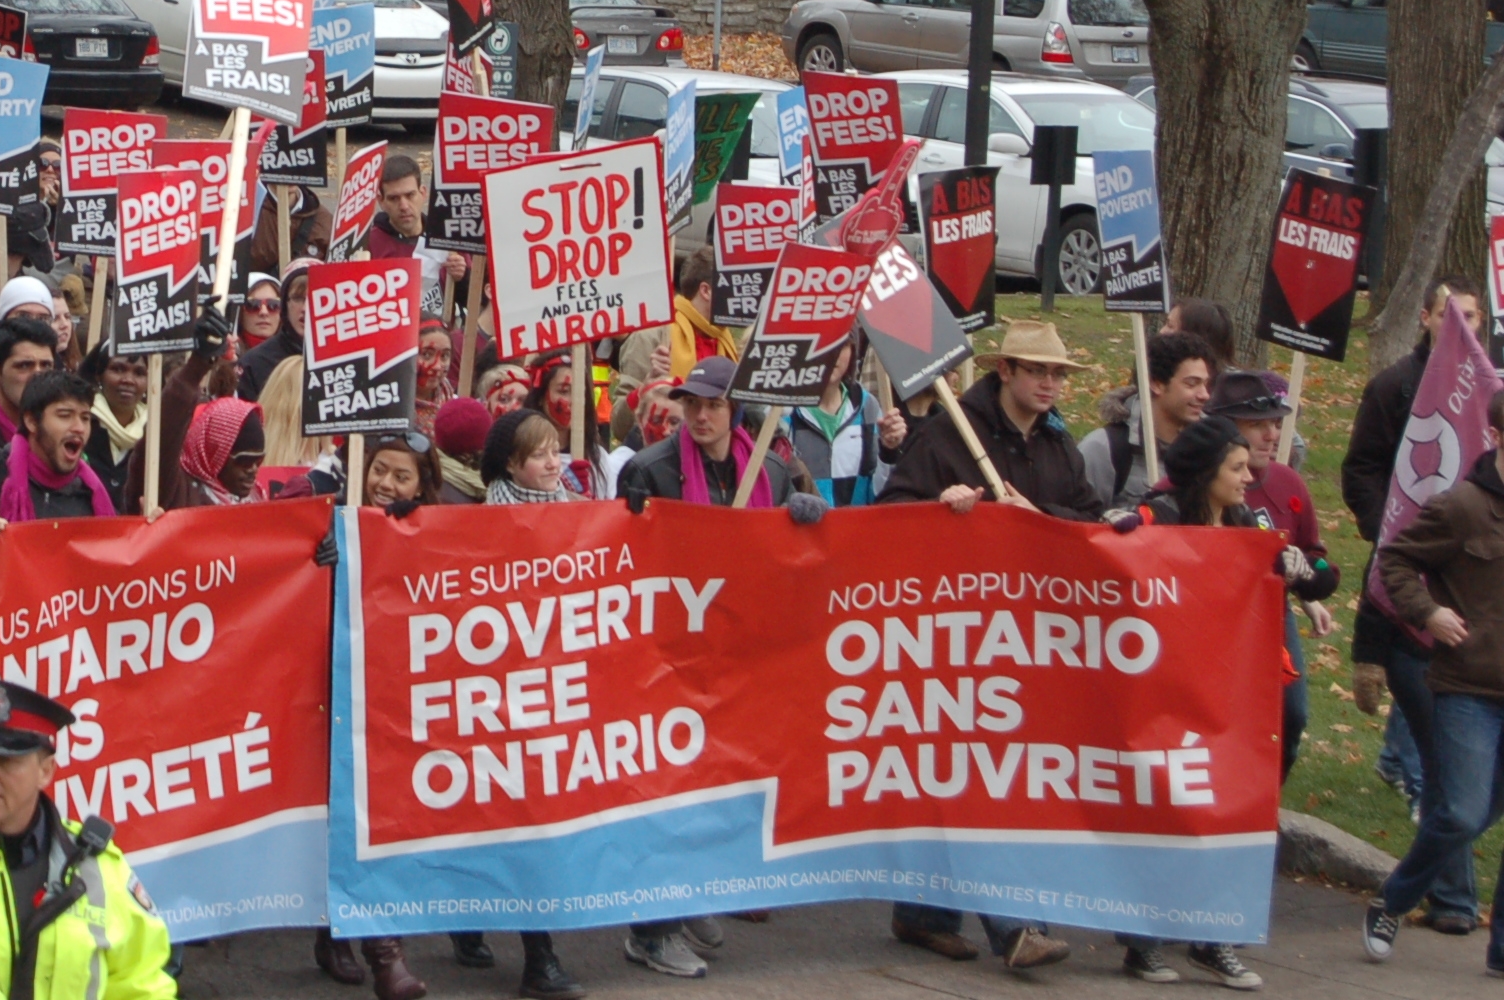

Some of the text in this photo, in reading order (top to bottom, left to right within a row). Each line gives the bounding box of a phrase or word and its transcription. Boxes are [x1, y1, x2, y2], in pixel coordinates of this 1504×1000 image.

[213, 55, 245, 70] LES
[809, 88, 888, 119] DROP
[442, 114, 541, 142] DROP
[813, 114, 896, 146] FEES!
[445, 142, 540, 171] FEES!
[339, 153, 382, 202] DROP
[831, 180, 856, 195] LES
[956, 176, 991, 207] BAS
[1096, 166, 1134, 198] END
[77, 210, 105, 223] LES
[122, 181, 197, 229] DROP
[336, 175, 380, 229] FEES!
[451, 204, 481, 218] LES
[522, 167, 644, 243] STOP!
[1099, 186, 1154, 222] POVERTY
[1285, 177, 1364, 229] À BAS
[124, 212, 197, 261] FEES!
[932, 209, 993, 246] LES FRAIS
[1278, 218, 1355, 260] LES FRAIS
[528, 232, 632, 290] DROP
[777, 266, 873, 294] DROP
[861, 244, 918, 311] FEES
[1105, 266, 1163, 296] PAUVRETÉ
[1110, 264, 1123, 278] LA
[132, 297, 157, 316] LES
[311, 268, 409, 318] DROP
[542, 293, 623, 320] AND LET US
[556, 279, 598, 301] FEES
[732, 284, 761, 297] LES
[770, 296, 860, 323] FEES!
[128, 300, 191, 341] FRAIS!
[315, 298, 411, 347] FEES!
[508, 302, 661, 357] ENROLL
[749, 364, 825, 391] FRAIS!
[761, 356, 790, 370] LES
[318, 381, 400, 421] FRAIS!
[324, 379, 355, 399] LES
[36, 568, 189, 629] APPUYONS
[195, 555, 236, 591] UN
[404, 543, 635, 604] WE SUPPORT A
[828, 571, 1179, 615] NOUS APPUYONS UN
[407, 576, 727, 674] POVERTY
[825, 610, 1160, 676] ONTARIO
[409, 661, 591, 742] FREE
[823, 675, 1023, 741] SANS
[411, 706, 706, 810] ONTARIO
[827, 731, 1214, 807] PAUVRETÉ
[338, 868, 1244, 927] CANADIAN FEDERATION OF STUDENTS-ONTARIO FÉDÉRATION CANADIENNE DES ÉTUDIANTES ET ÉTUDIANTS-ONTARIO
